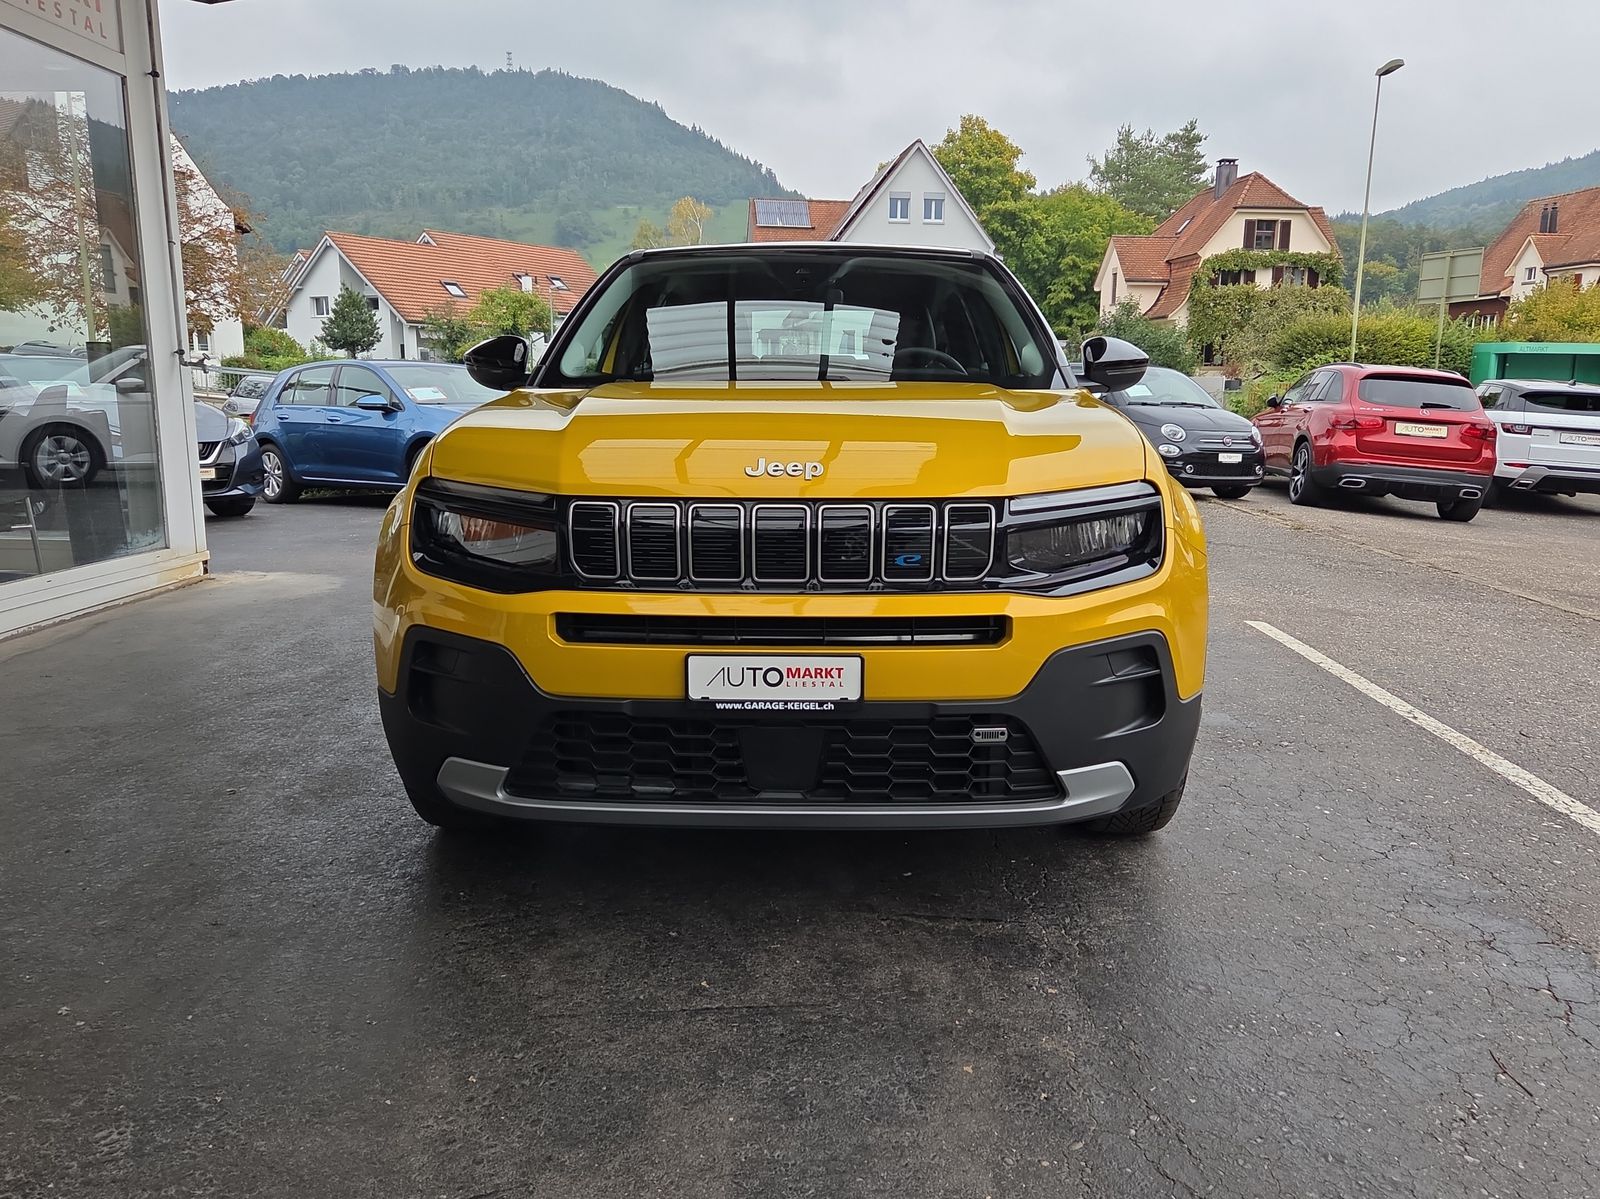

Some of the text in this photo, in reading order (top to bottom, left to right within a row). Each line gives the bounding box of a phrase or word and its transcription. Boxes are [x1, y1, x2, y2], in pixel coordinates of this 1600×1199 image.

[744, 457, 824, 480] Jeep
[706, 666, 845, 688] AUTO MARKT
[715, 701, 835, 711] www.GARAGE-KEIGEL.ch
